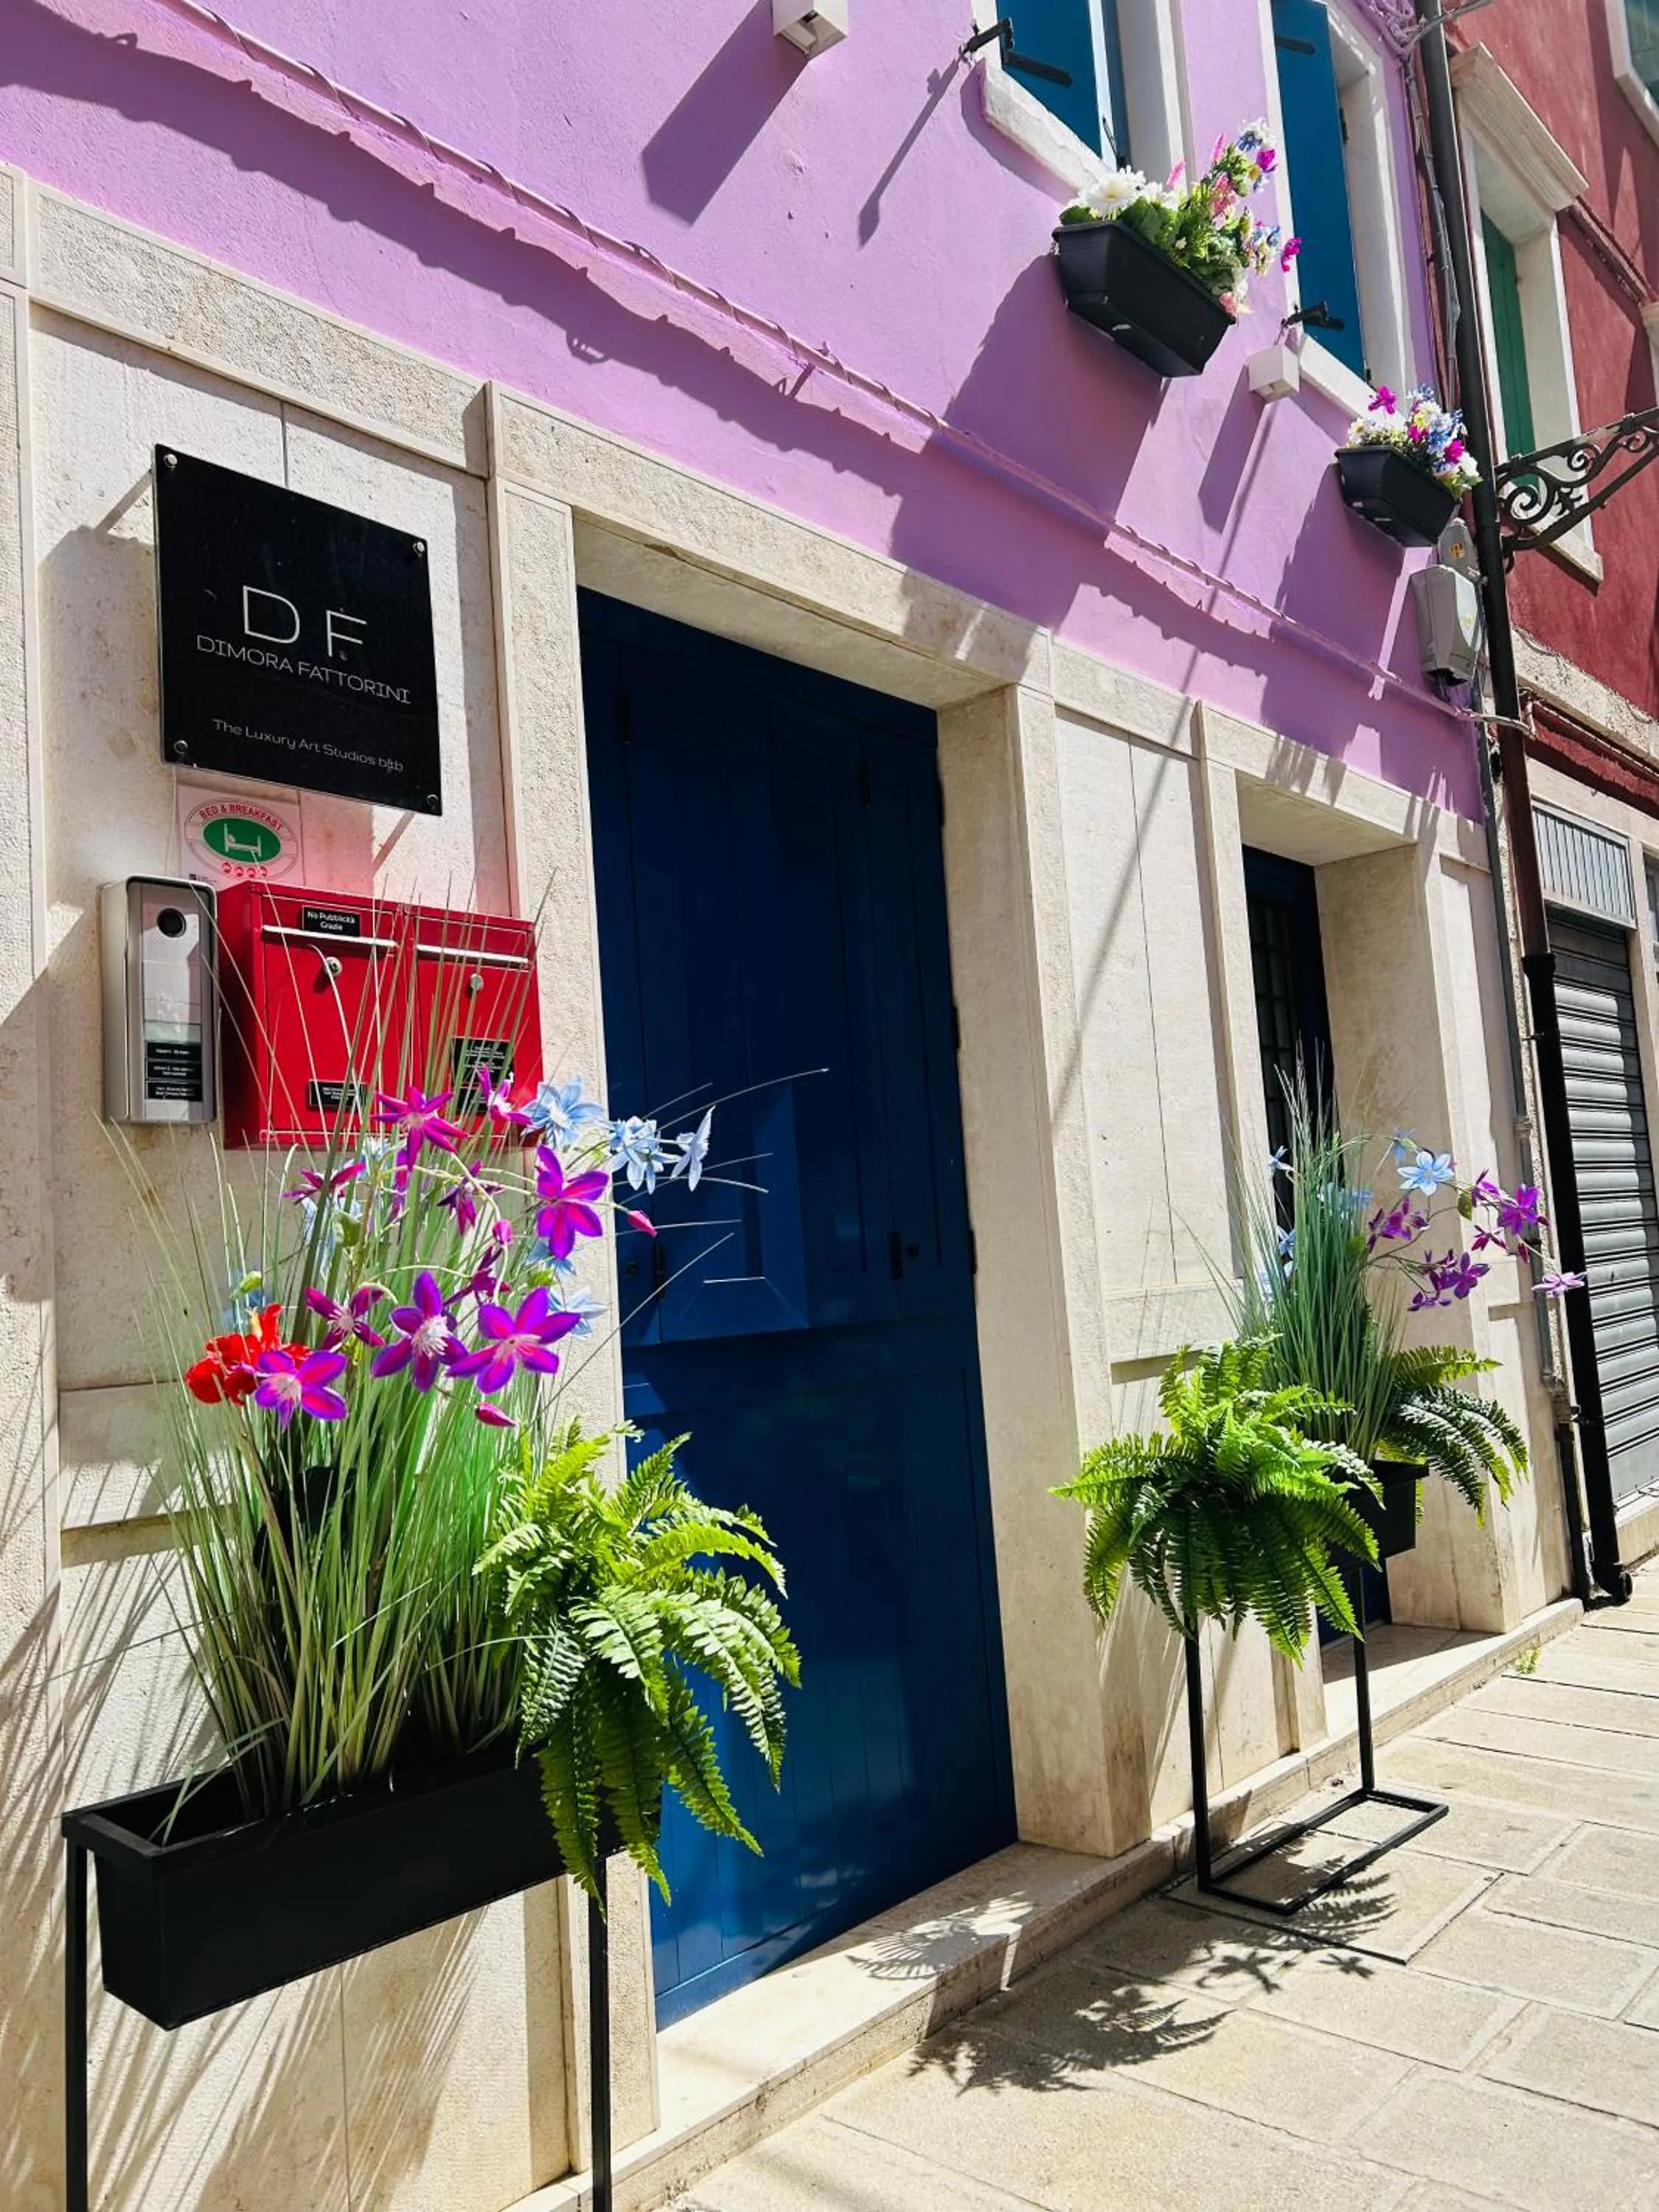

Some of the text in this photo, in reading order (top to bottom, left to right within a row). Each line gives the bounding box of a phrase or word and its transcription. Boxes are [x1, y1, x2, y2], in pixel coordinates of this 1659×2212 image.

[243, 585, 367, 657] D F
[197, 635, 411, 704] DIMORA FATTORINI
[212, 719, 243, 735] The
[246, 726, 296, 749] Luxury
[299, 738, 321, 753] Art
[322, 744, 376, 766] Studios
[198, 806, 218, 820] BED
[229, 804, 285, 831] BREAKFAST
[307, 911, 319, 919] No
